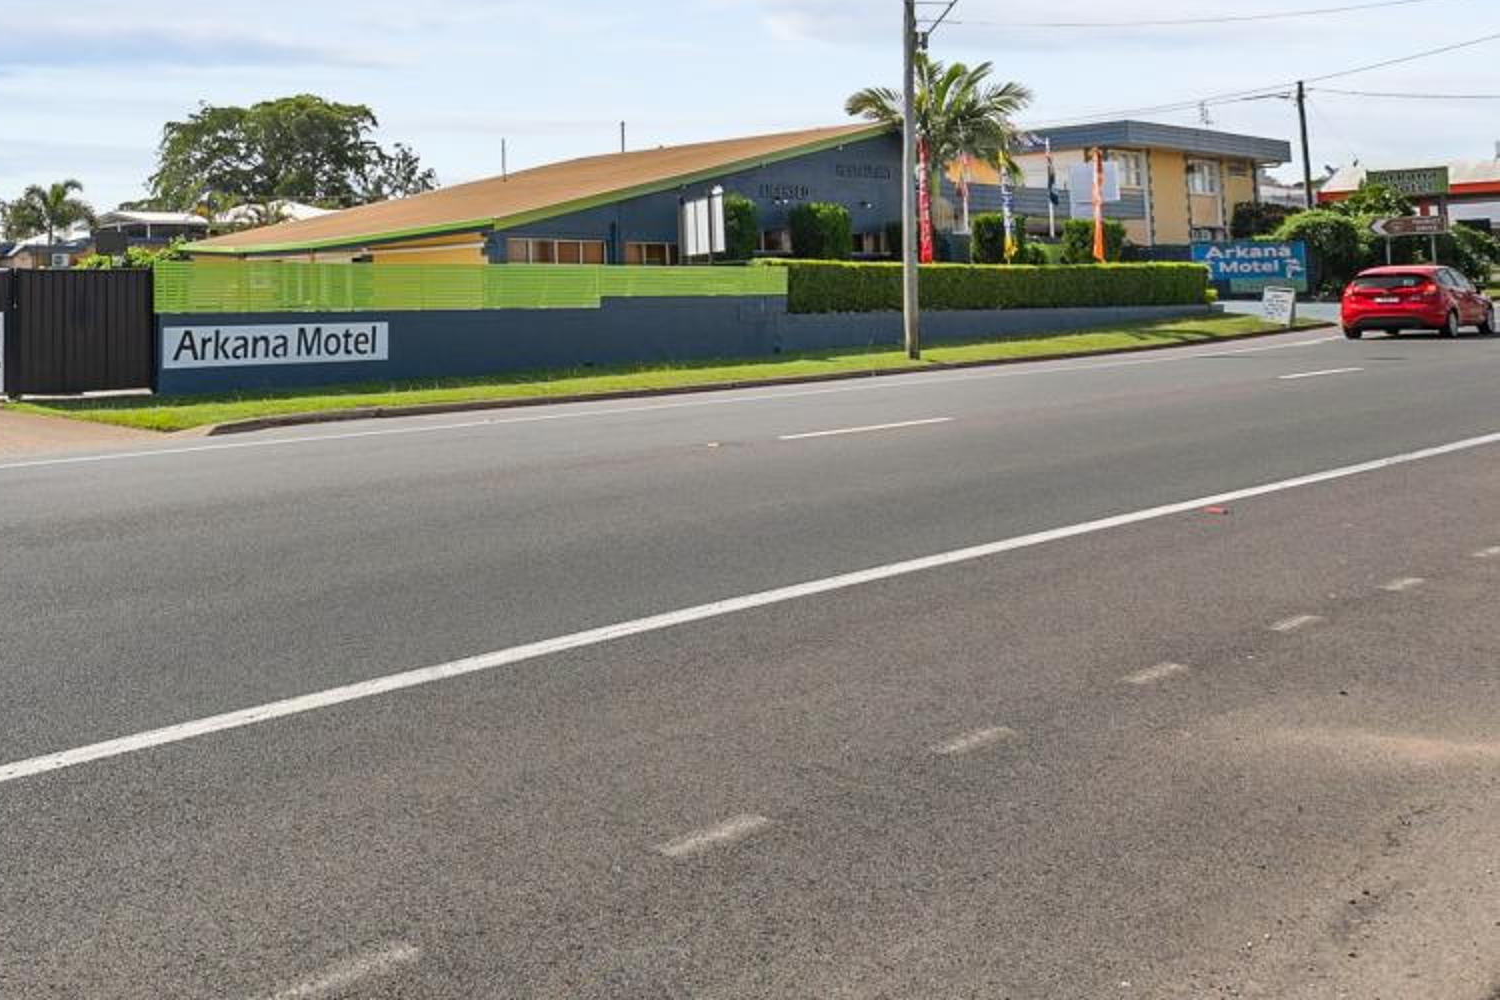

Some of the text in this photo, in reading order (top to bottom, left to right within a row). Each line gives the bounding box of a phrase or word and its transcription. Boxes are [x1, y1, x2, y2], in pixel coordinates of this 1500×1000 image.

[1204, 245, 1291, 258] Arkana
[1219, 259, 1279, 273] Motel
[173, 325, 378, 361] Arkana Motel
